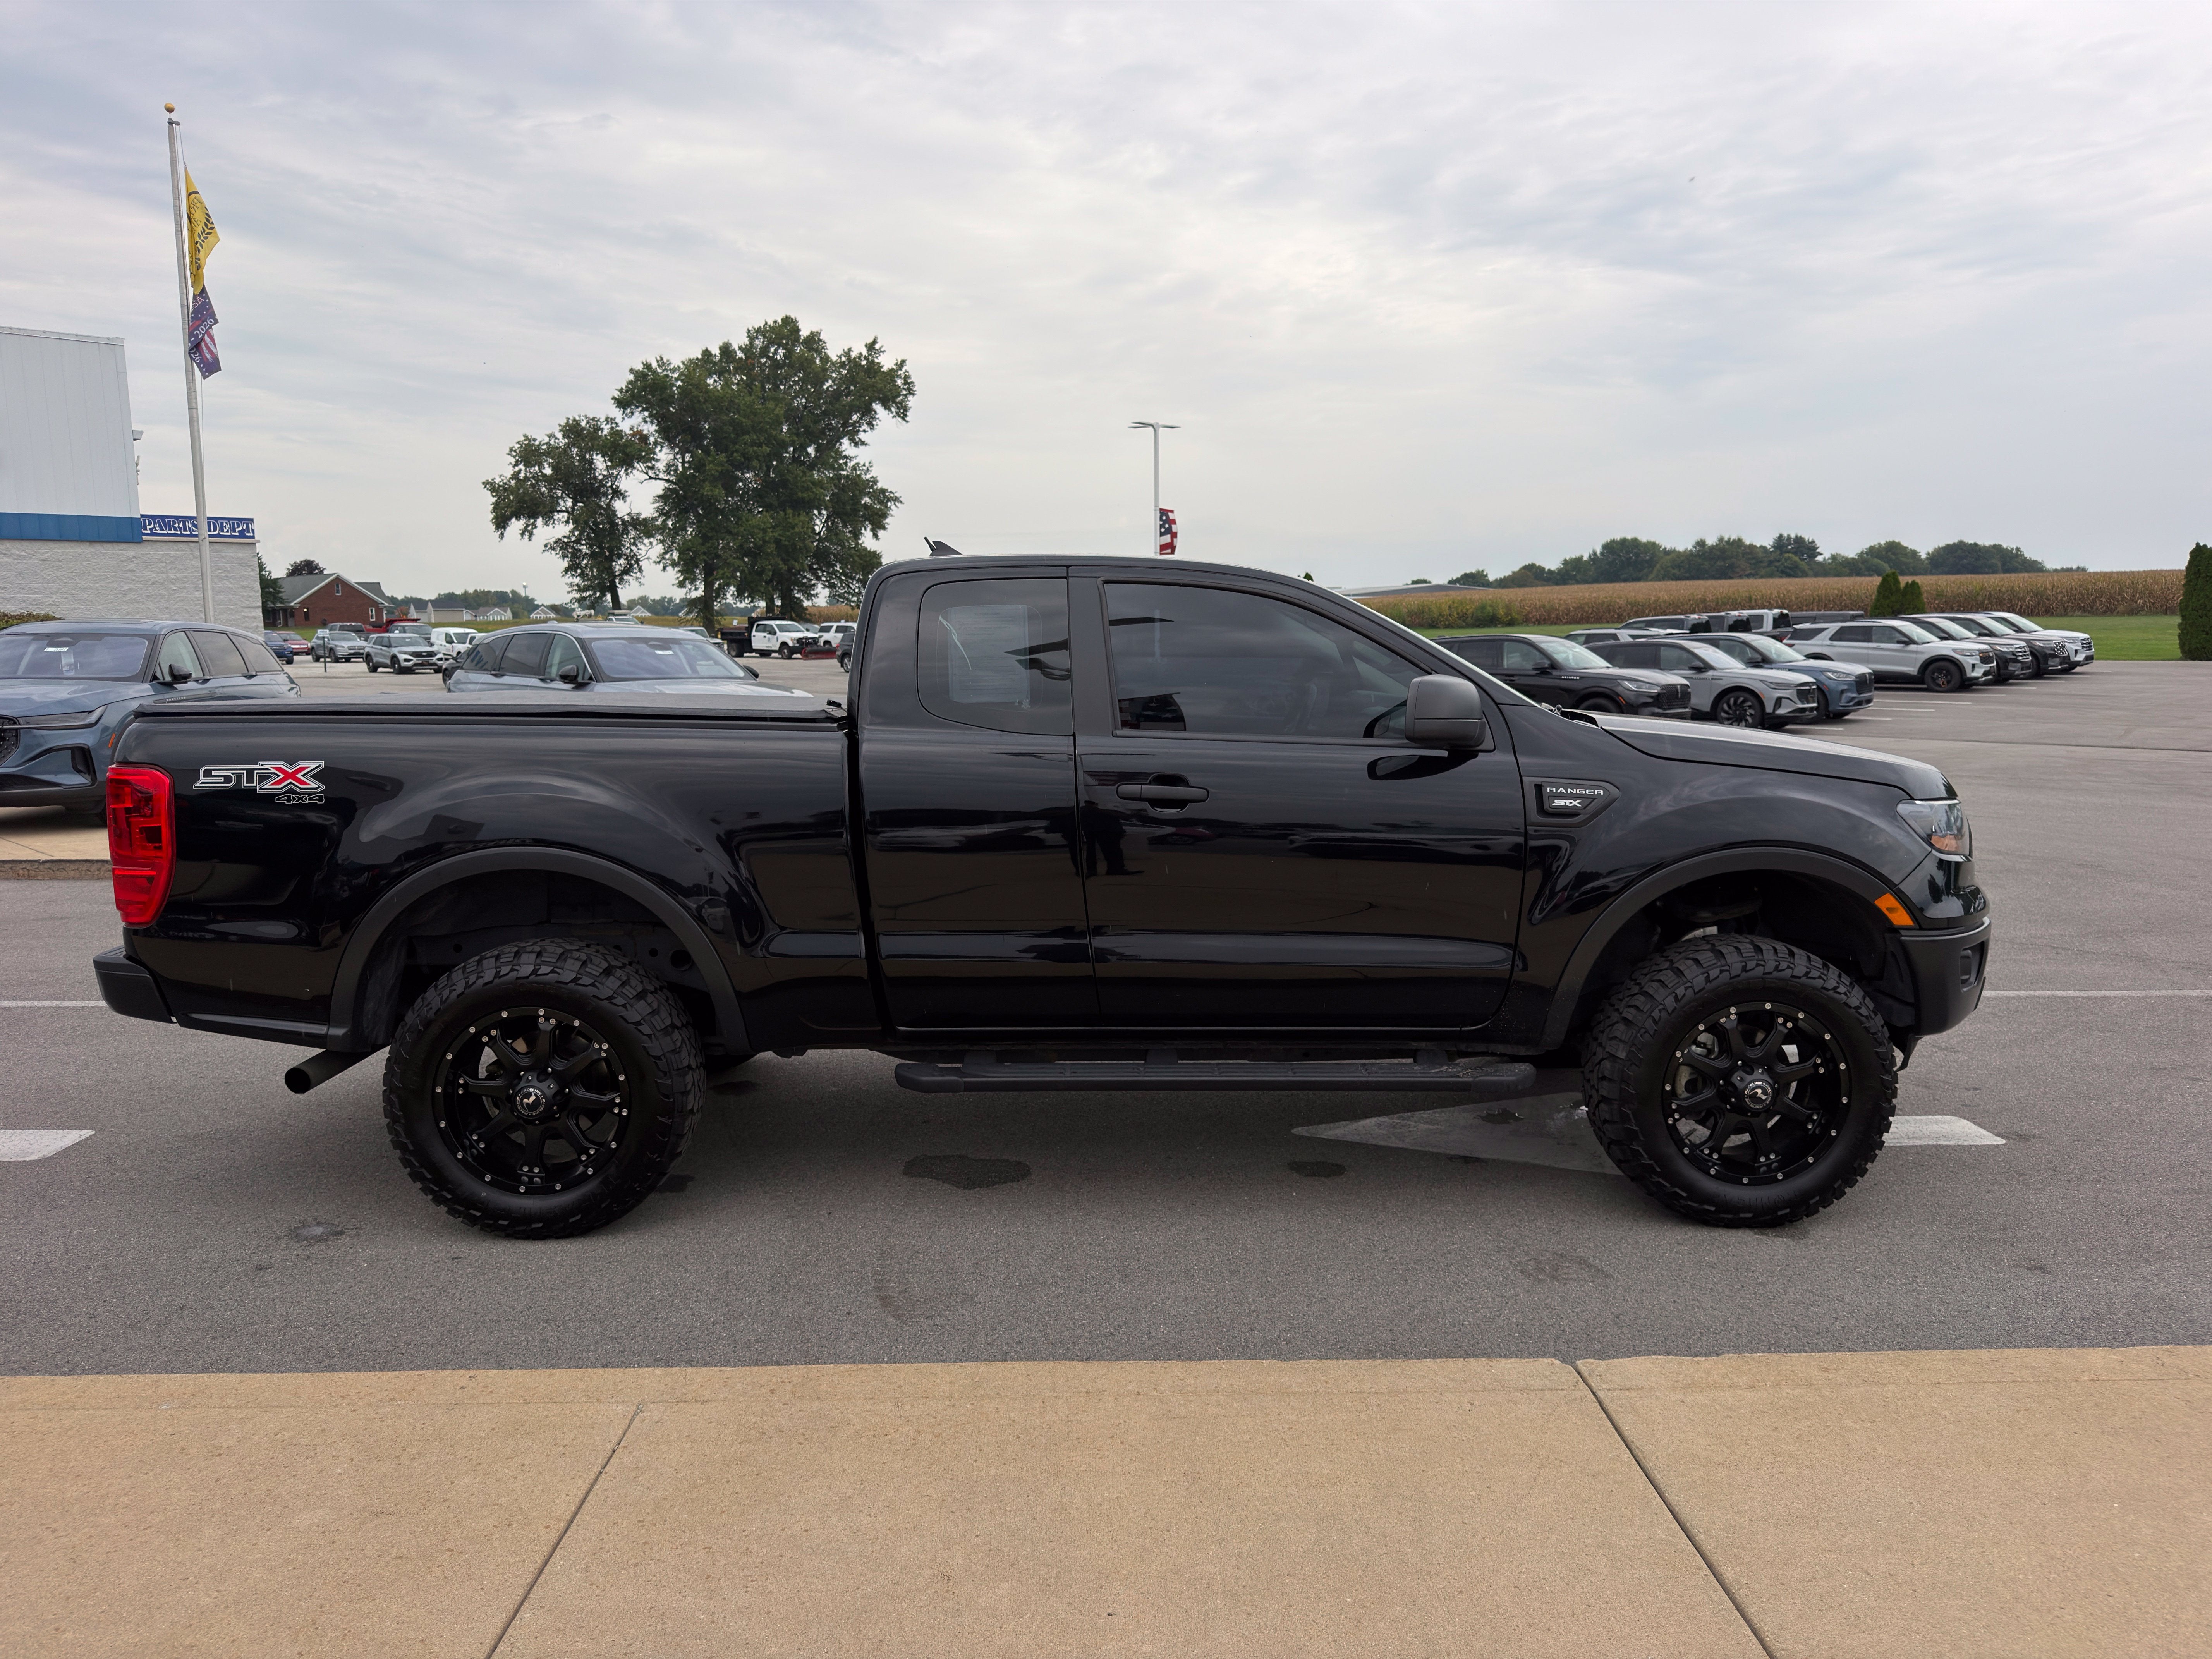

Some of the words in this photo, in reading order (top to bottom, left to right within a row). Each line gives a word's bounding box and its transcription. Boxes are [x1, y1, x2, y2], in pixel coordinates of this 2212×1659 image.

[194, 317, 214, 339] 2026
[141, 518, 198, 534] PARTS
[206, 520, 254, 536] DEPT
[193, 761, 325, 793] STX
